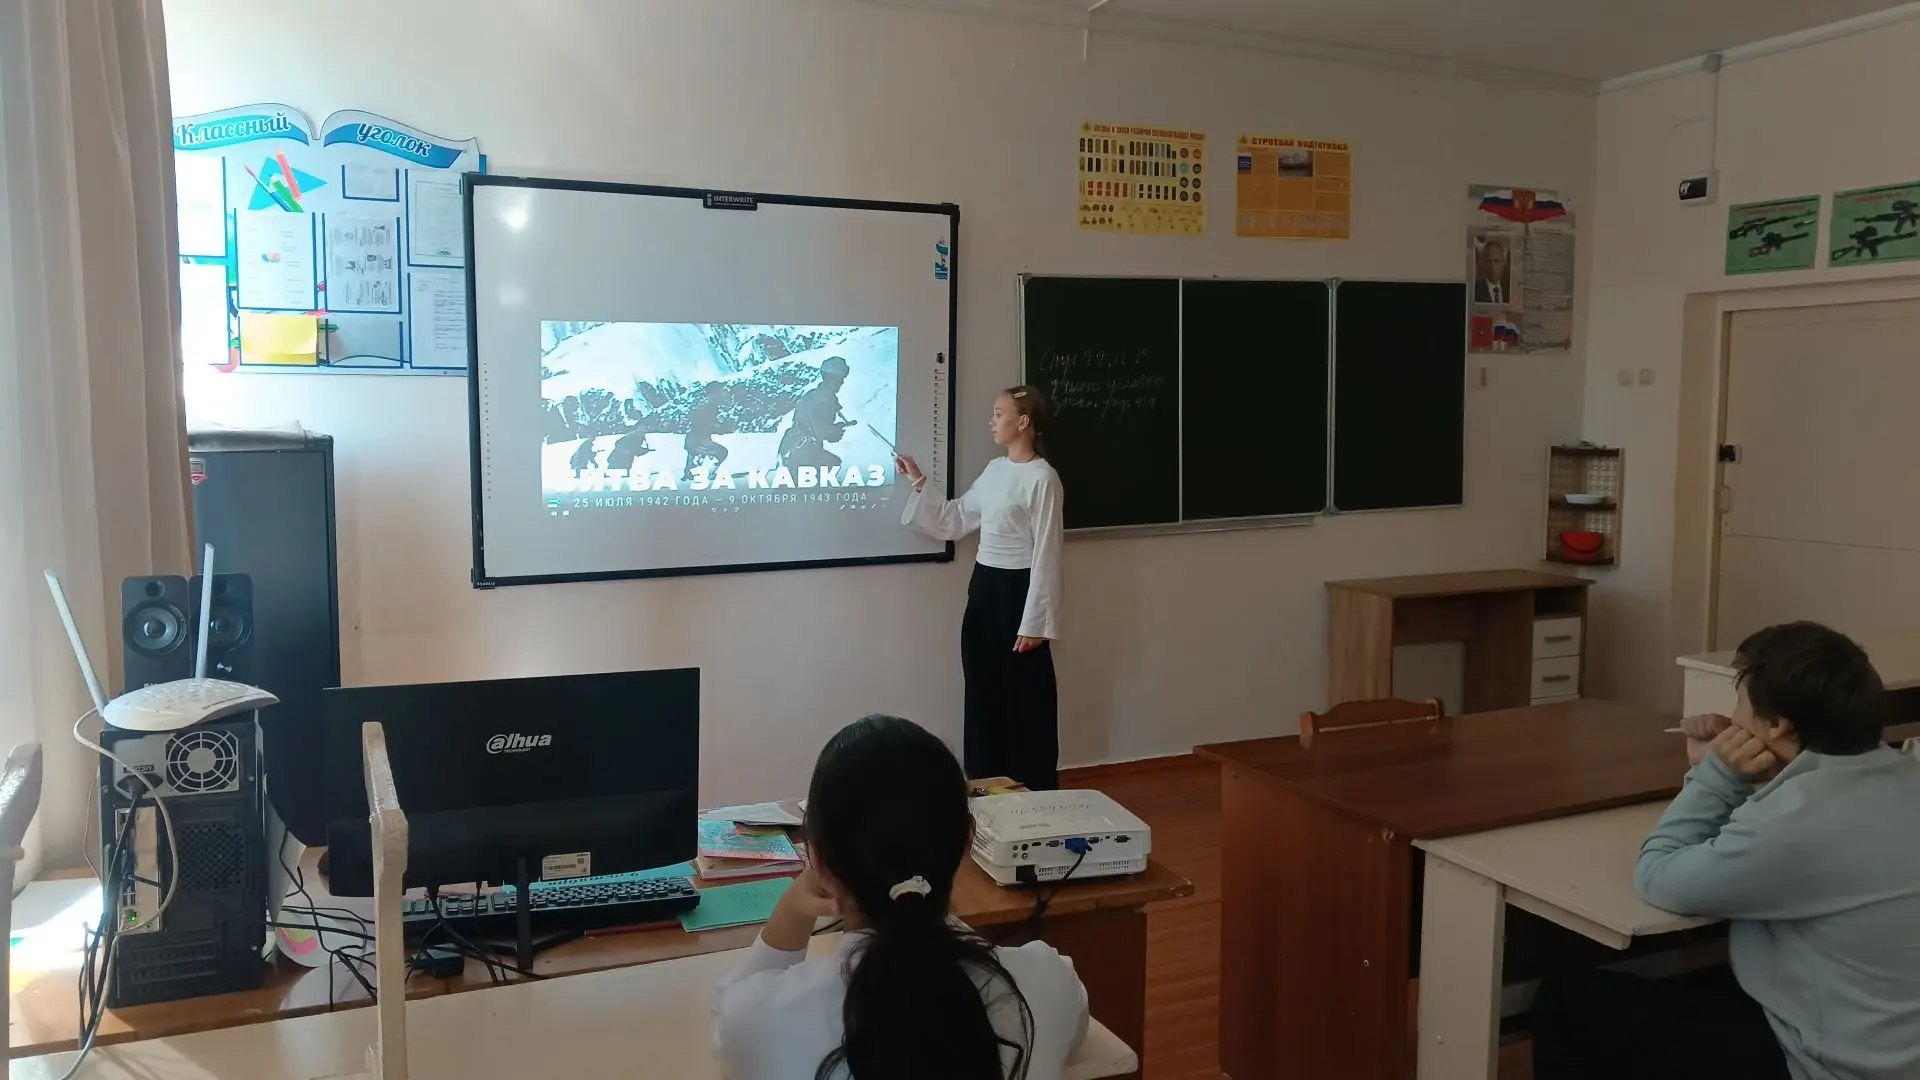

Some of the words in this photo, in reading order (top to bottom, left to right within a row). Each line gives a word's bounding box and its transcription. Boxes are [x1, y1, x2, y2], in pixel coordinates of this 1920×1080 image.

[176, 111, 291, 146] Классный
[358, 122, 431, 156] уголок
[713, 195, 755, 204] INTERWRITE
[690, 466, 736, 490] ЗА
[748, 464, 886, 489] КАВКАЗ
[574, 497, 589, 508] 25
[595, 496, 632, 507] ИЮЛЯ
[640, 496, 669, 506] 1942
[675, 495, 708, 506] ГОДА
[729, 495, 735, 504] 9
[741, 493, 797, 504] ОКТЯБРЯ
[803, 492, 831, 502] 1943
[836, 492, 867, 503] ГОДА
